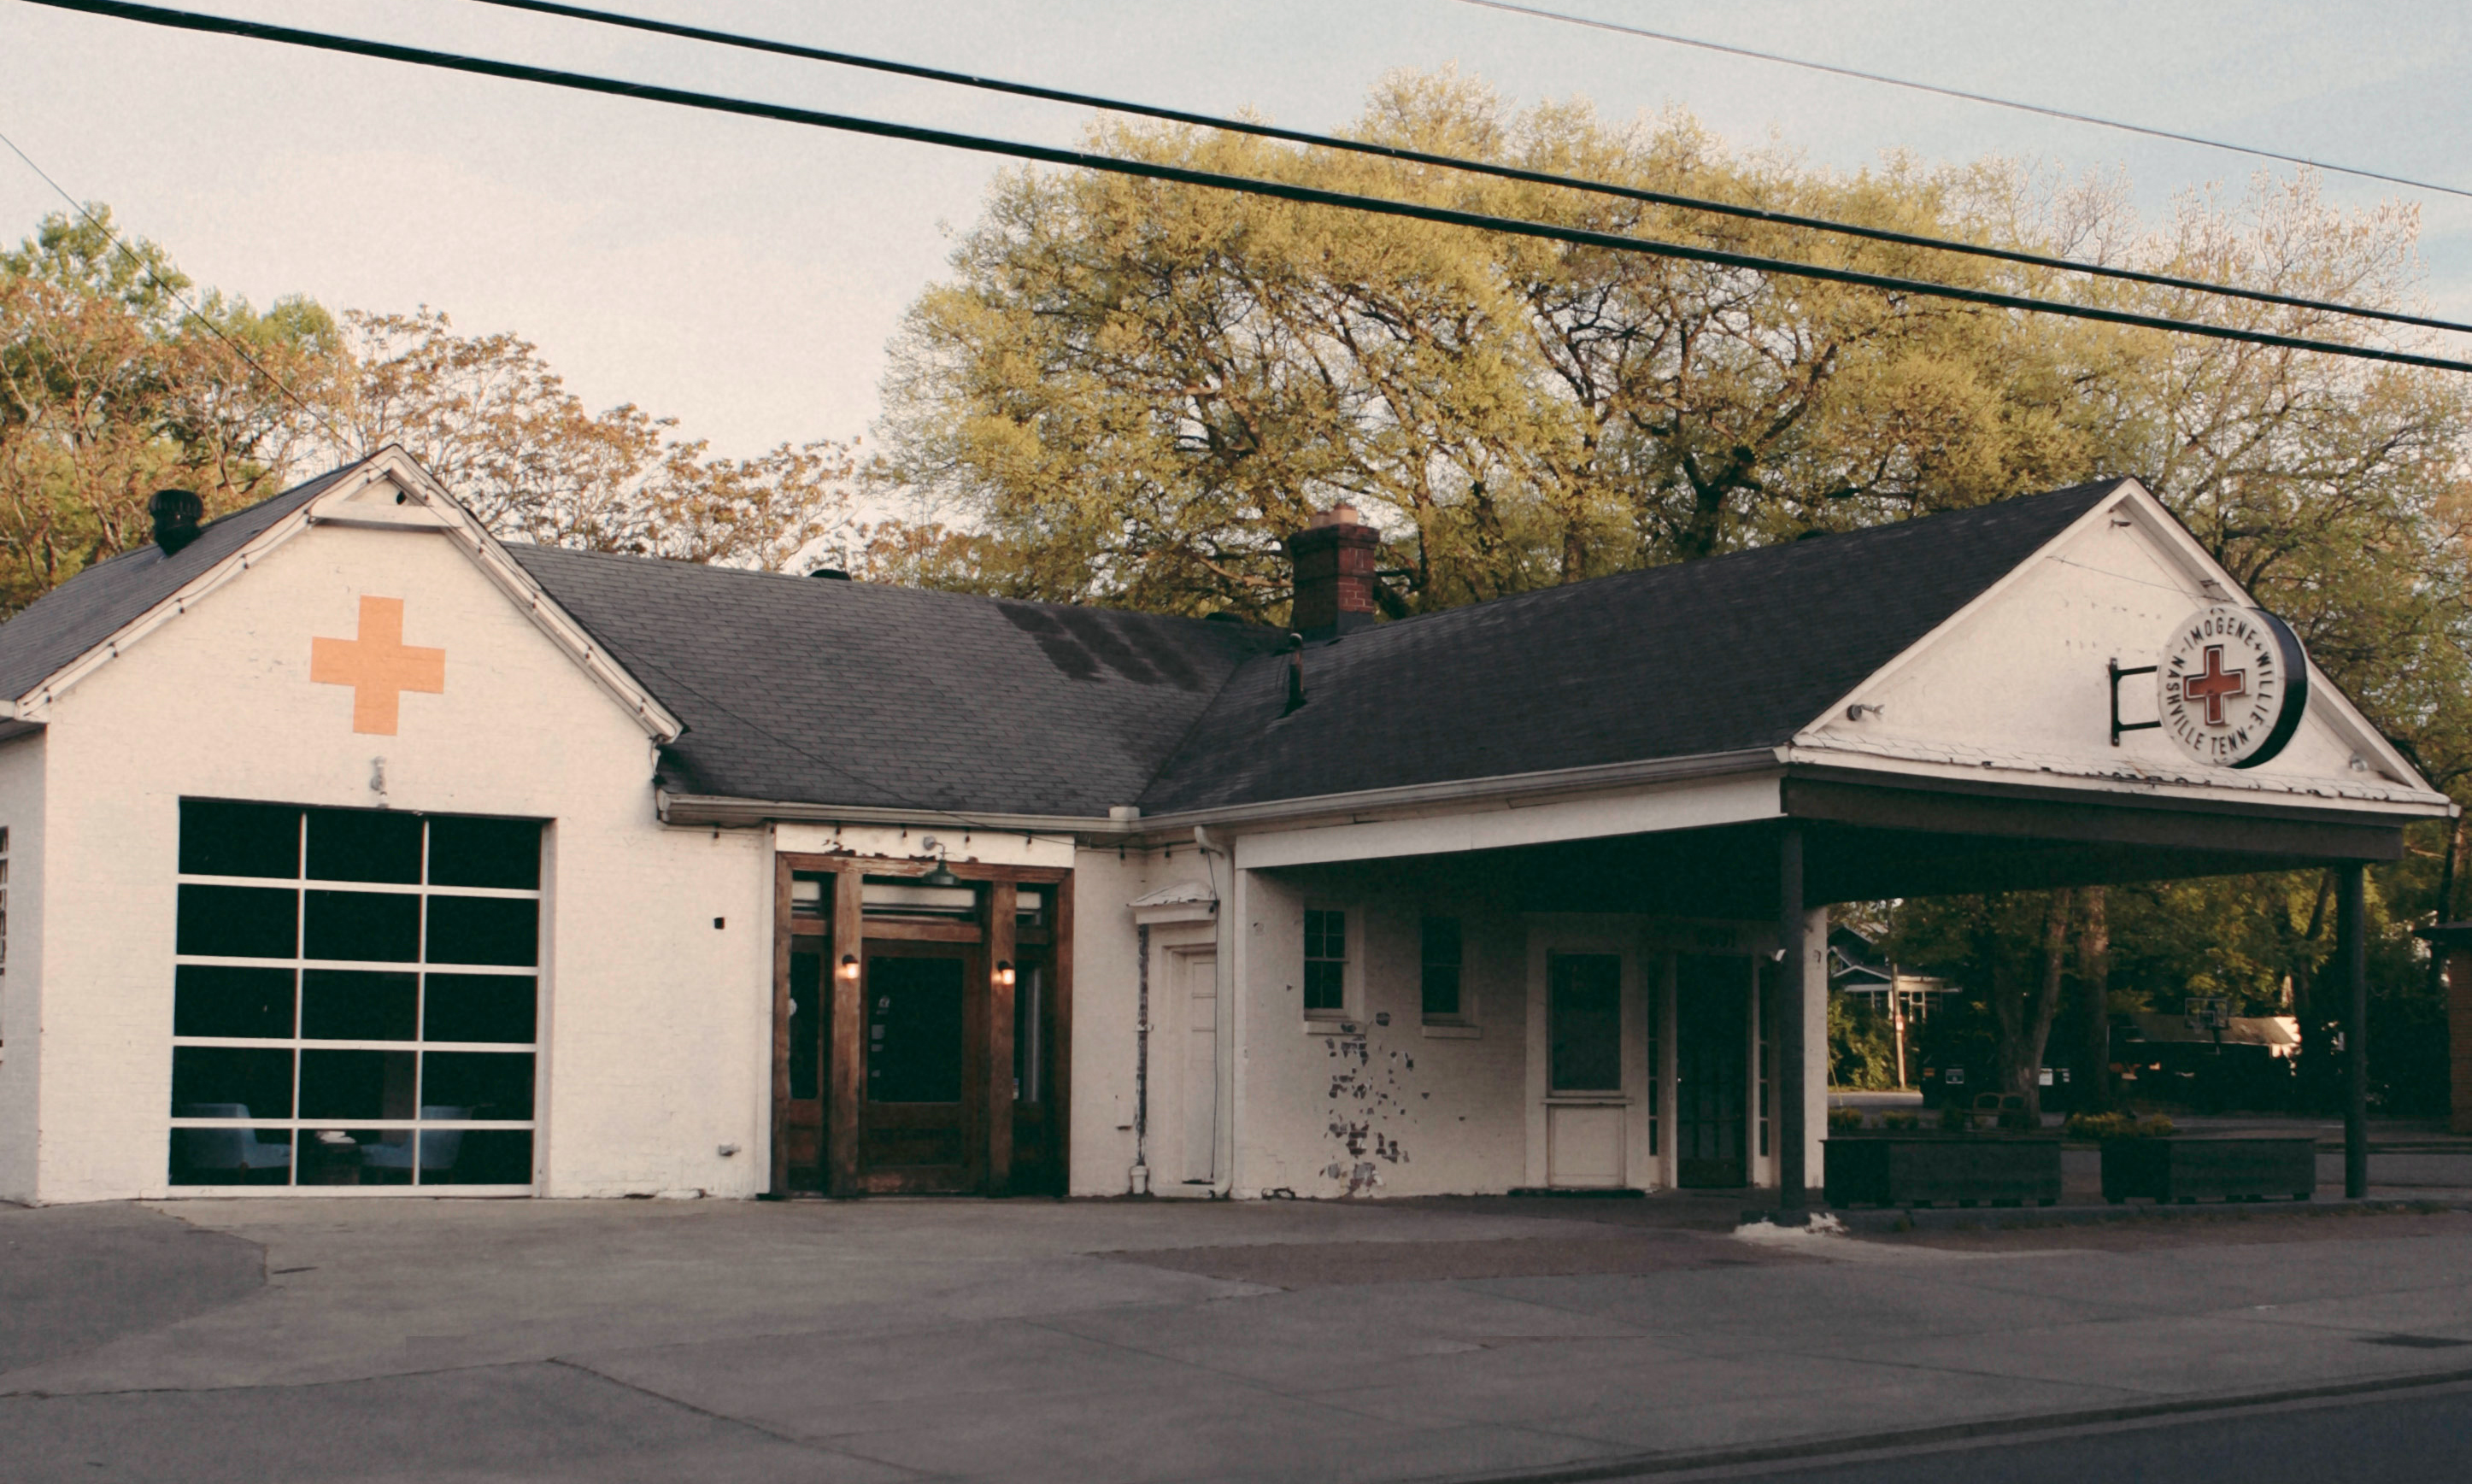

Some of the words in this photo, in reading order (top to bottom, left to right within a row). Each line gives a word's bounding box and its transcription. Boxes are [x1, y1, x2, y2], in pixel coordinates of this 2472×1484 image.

[2166, 655, 2205, 750] NASHVILLE
[2211, 727, 2250, 755] TENN
[2183, 617, 2258, 650] IMOGENE
[2248, 651, 2274, 726] WILLIE
